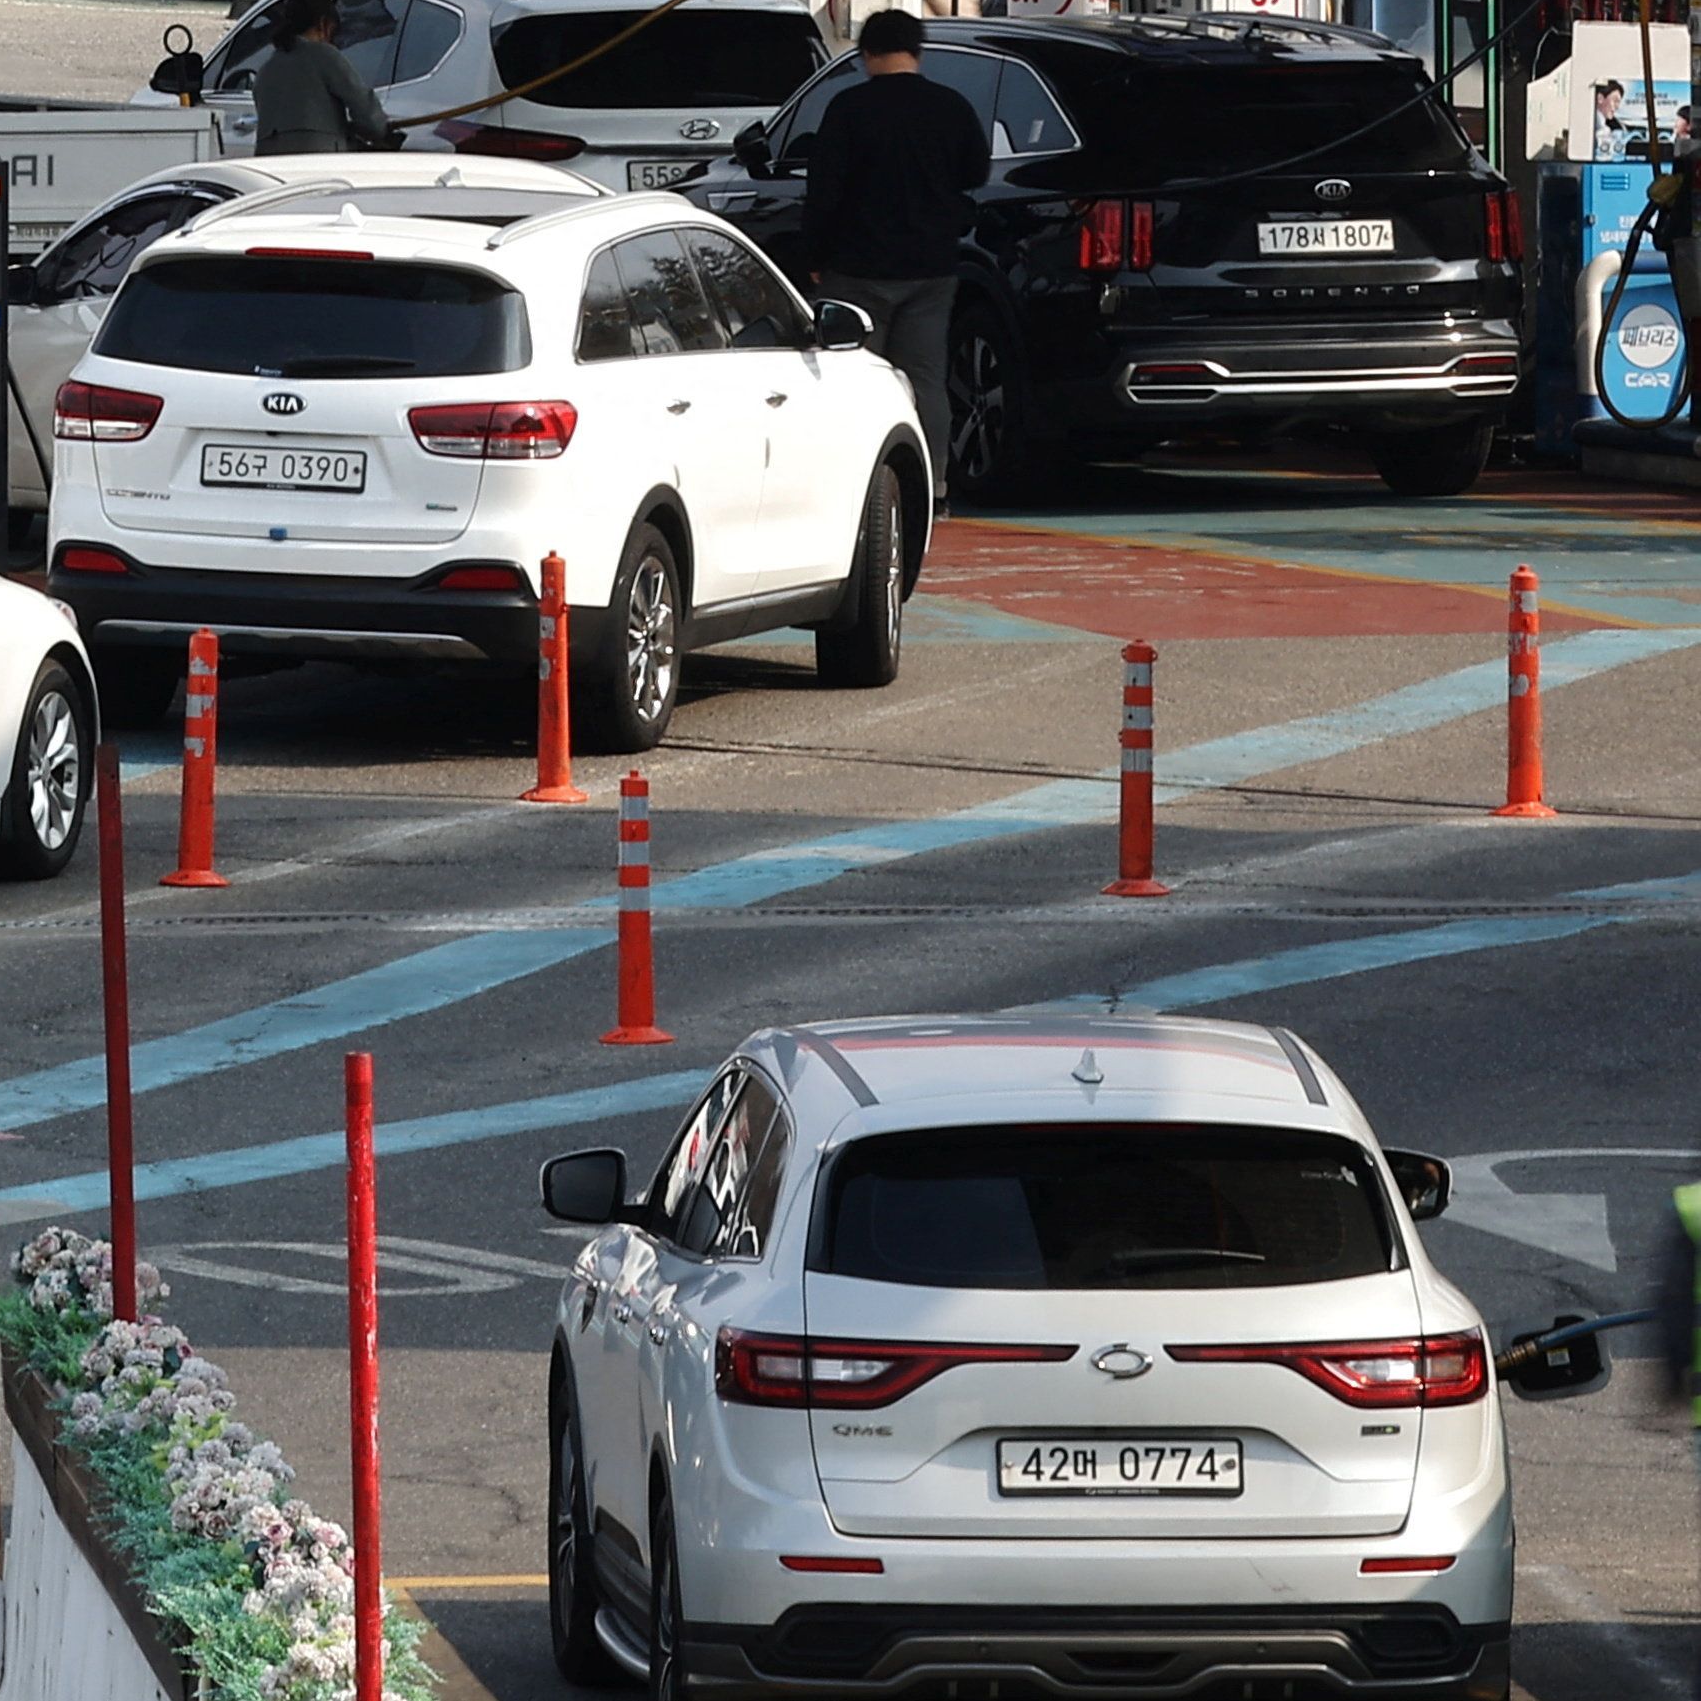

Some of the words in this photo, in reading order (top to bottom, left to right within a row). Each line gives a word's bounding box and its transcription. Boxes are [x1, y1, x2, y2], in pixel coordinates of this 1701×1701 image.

[1321, 184, 1347, 196] KIA
[1332, 224, 1385, 247] 1807
[1245, 285, 1420, 298] SORENTO
[1621, 325, 1678, 348] 페브리즈
[1624, 372, 1672, 389] CAR
[267, 396, 299, 411] KIA
[218, 451, 268, 478] 56구
[281, 454, 348, 483] 0390
[1021, 1449, 1098, 1482] 42머
[1118, 1448, 1219, 1482] 0774
